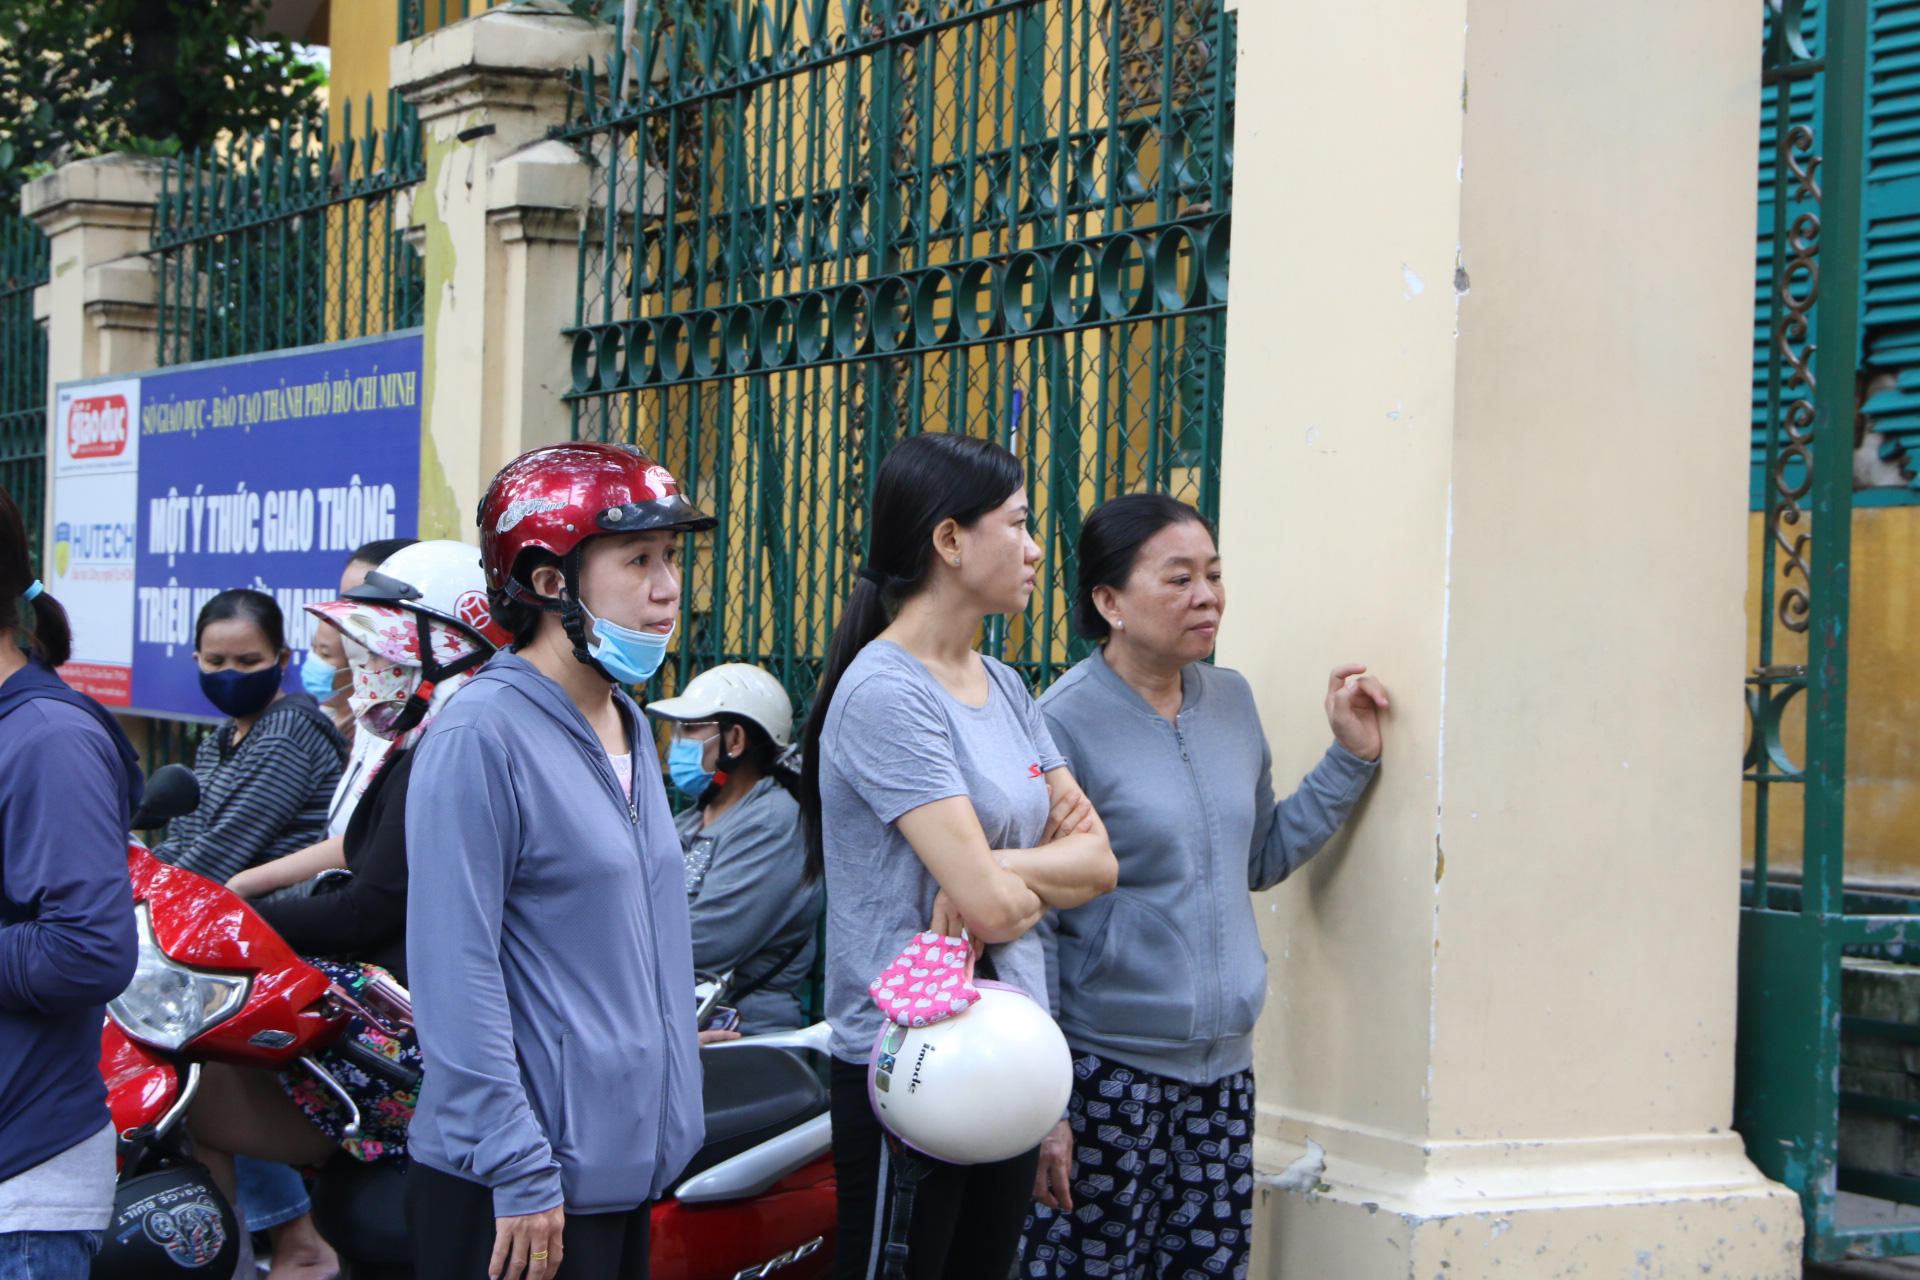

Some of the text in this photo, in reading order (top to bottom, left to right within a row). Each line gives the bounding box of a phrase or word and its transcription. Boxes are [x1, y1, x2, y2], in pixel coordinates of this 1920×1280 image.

[158, 393, 183, 433] GIÁO
[183, 398, 207, 438] DỤC
[212, 386, 237, 427] ĐÀO
[238, 391, 261, 433] TẠO
[263, 377, 304, 422] THÀNH
[304, 370, 331, 417] PHỐ
[332, 368, 353, 414] HỒ
[353, 365, 378, 412] CHÍ
[379, 371, 417, 409] MINH
[72, 524, 136, 559] HUTECH
[149, 474, 396, 567] MỘT Ý THỨC GIAO THÔNG
[138, 576, 191, 658] TRIỆU
[118, 1200, 156, 1225] BUILT
[157, 1185, 207, 1205] GARAGE
